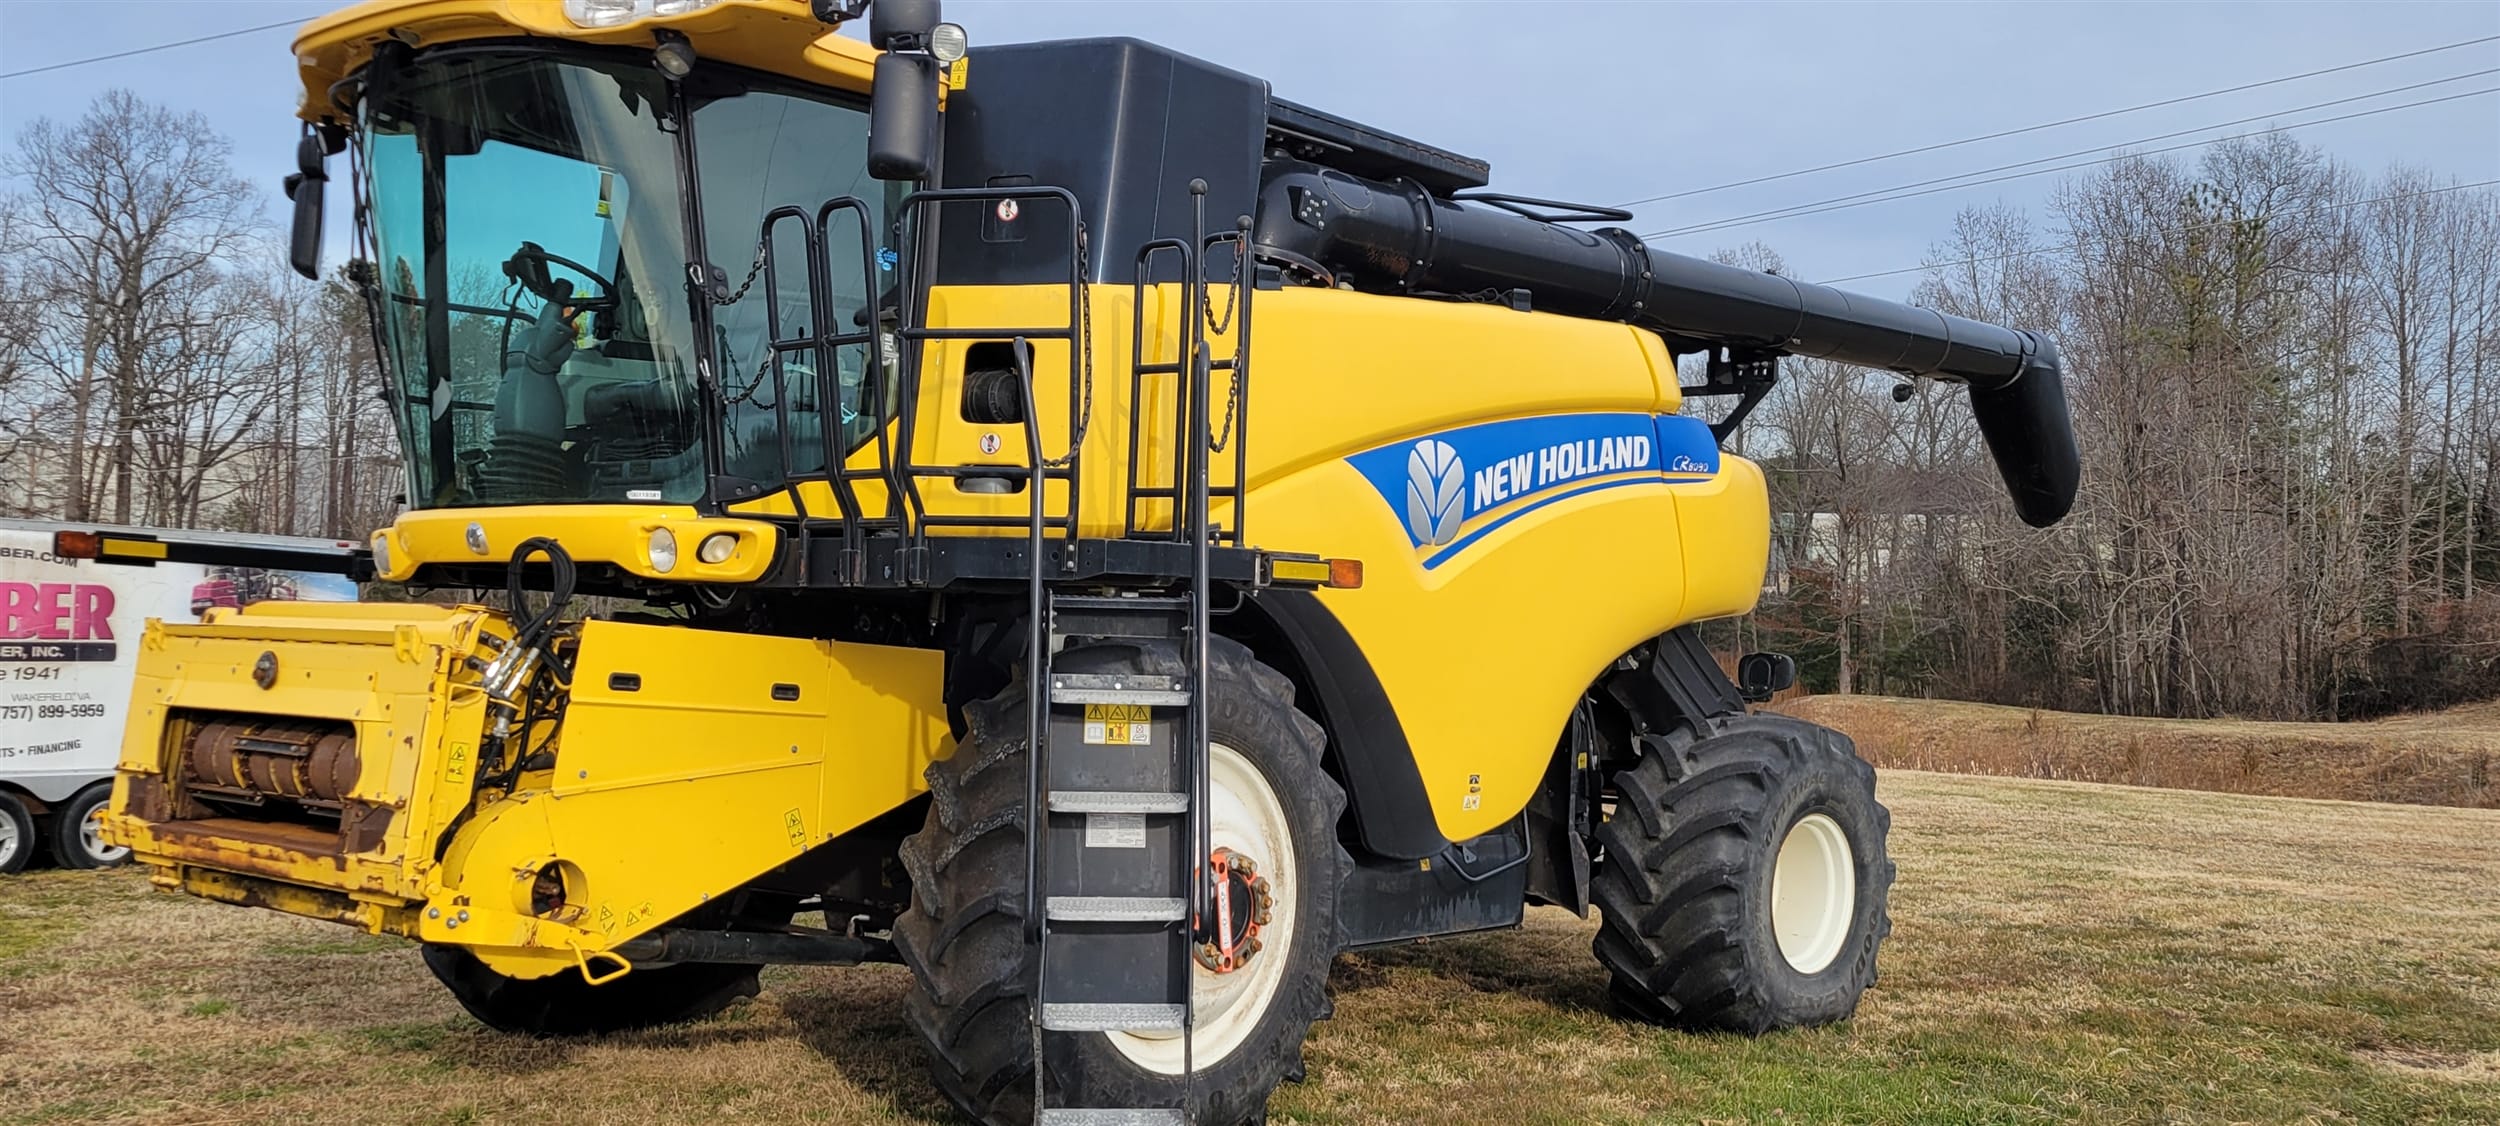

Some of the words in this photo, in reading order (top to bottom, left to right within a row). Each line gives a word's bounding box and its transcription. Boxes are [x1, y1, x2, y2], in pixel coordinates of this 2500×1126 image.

[1473, 451, 1534, 512] NEW
[1538, 436, 1650, 486] HOLLAND
[31, 646, 65, 657] INC.
[13, 666, 60, 680] 1941
[38, 704, 105, 719] 899-5959
[27, 738, 81, 756] FINANCING
